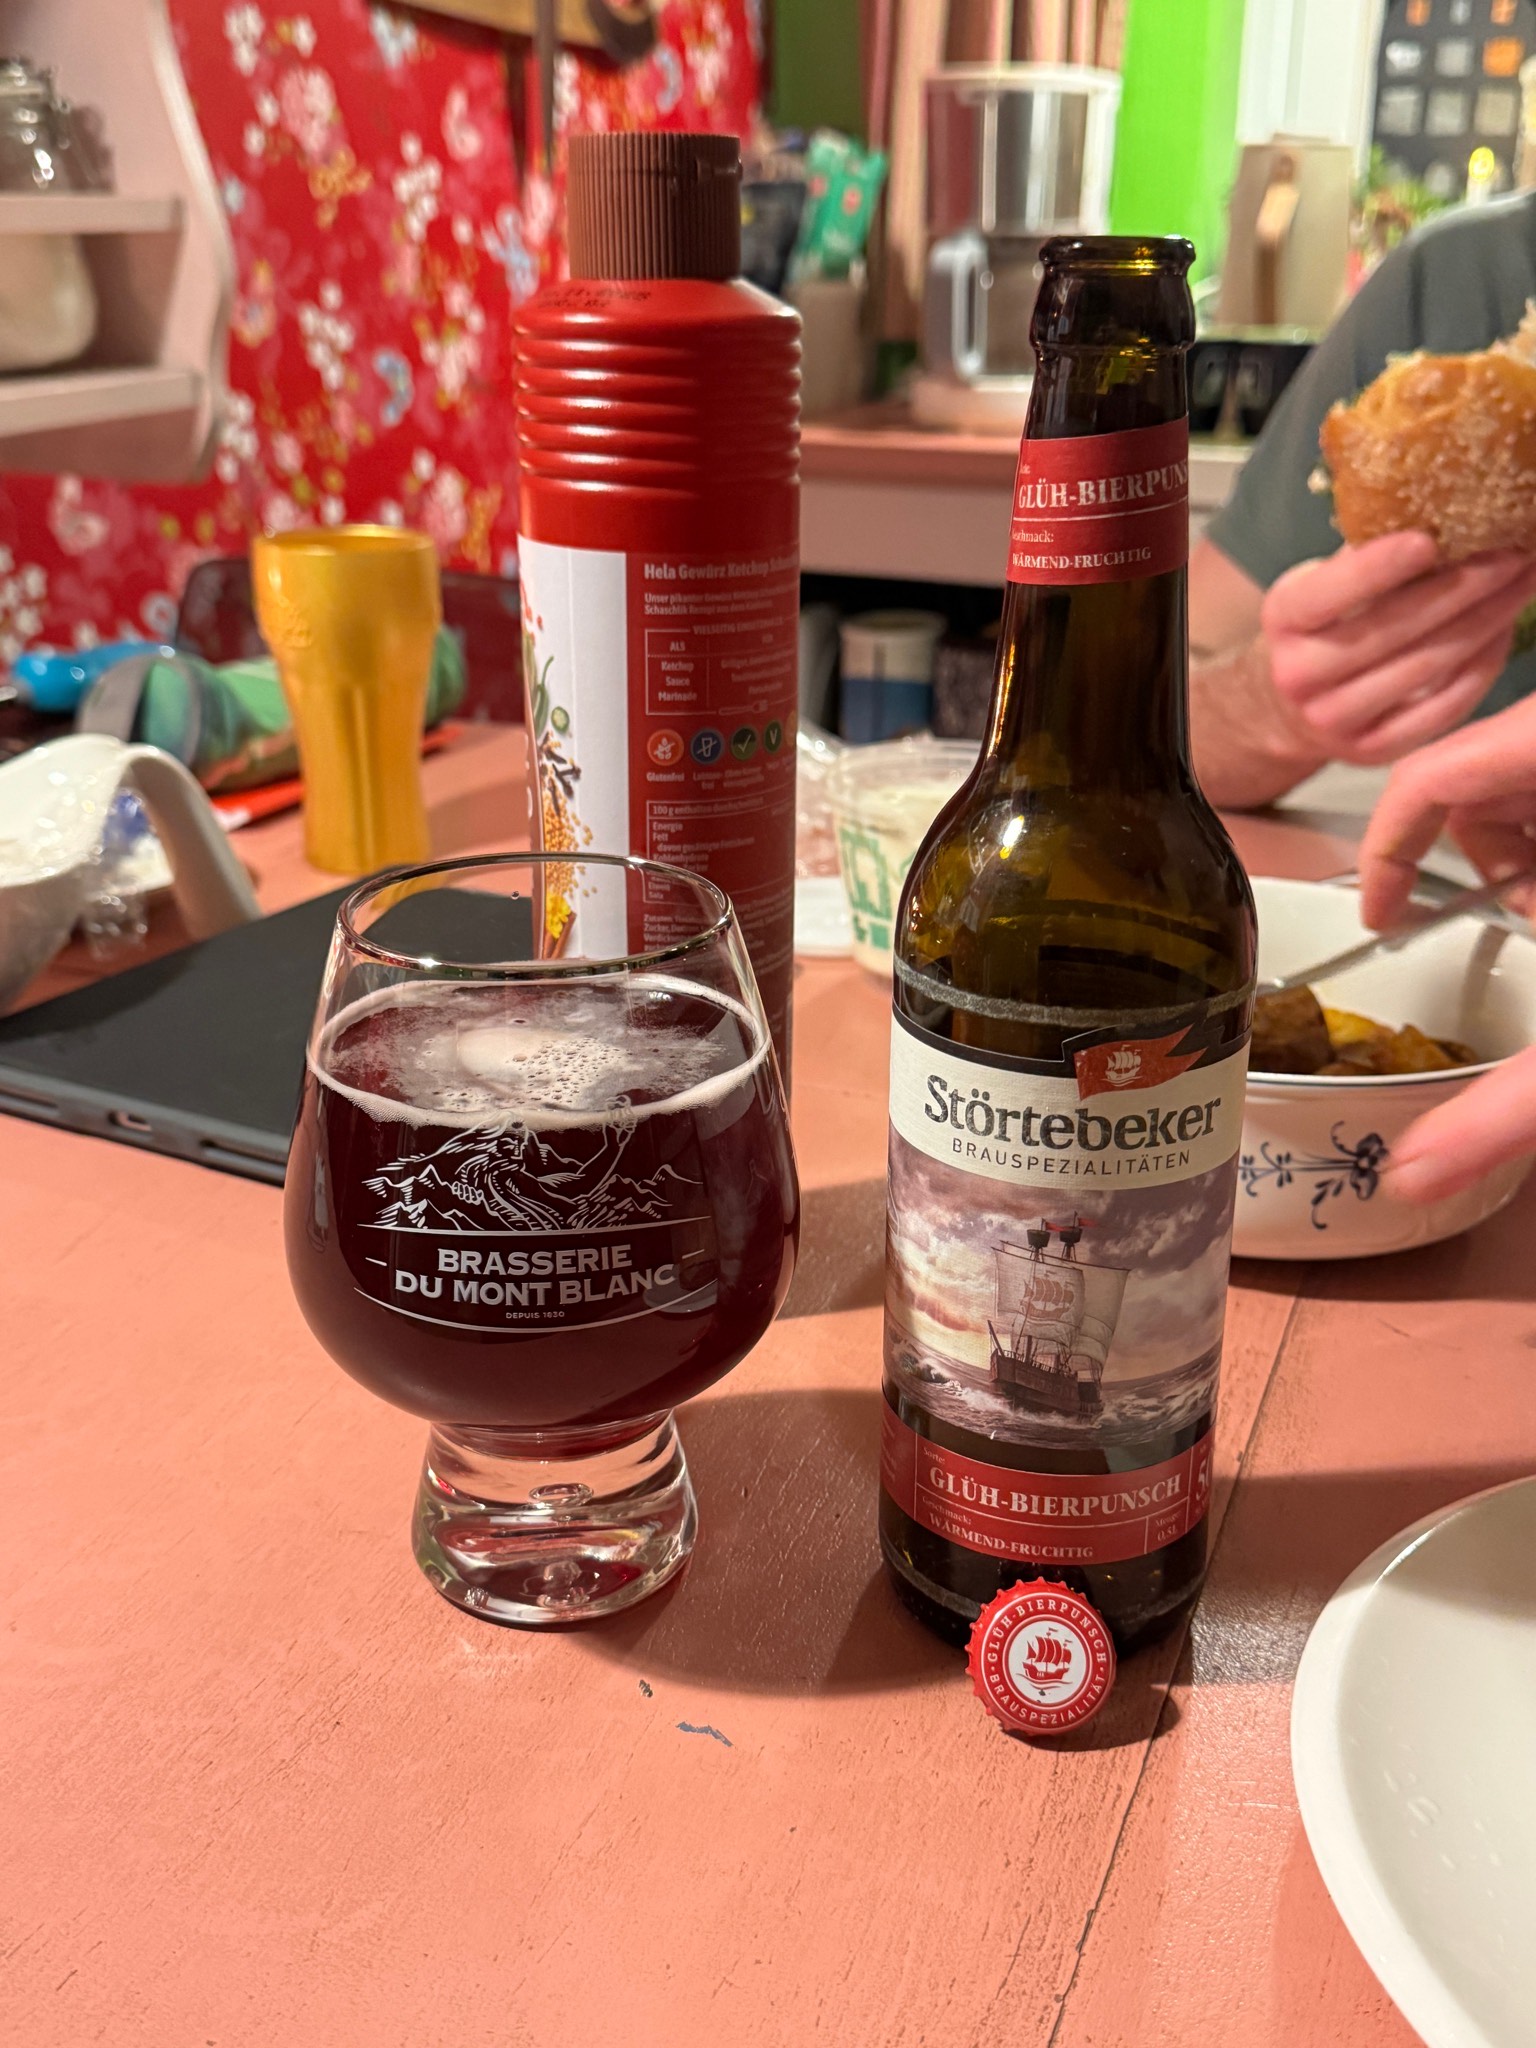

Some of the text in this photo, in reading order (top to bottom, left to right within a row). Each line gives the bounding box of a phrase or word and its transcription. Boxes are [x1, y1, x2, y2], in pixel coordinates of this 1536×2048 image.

[644, 562, 676, 580] Hela
[679, 563, 726, 580] Gewürz
[1012, 546, 1151, 569] WÄRMEND-FRUCHTIG
[669, 640, 686, 652] ALS
[665, 675, 690, 687] Sauce
[924, 1074, 1221, 1152] Störtebeker
[952, 1137, 1190, 1176] BRAUSPEZIALITÄTEN
[437, 1244, 633, 1276] BRASSERIE
[395, 1263, 678, 1307] DU MONT BLANC
[929, 1466, 1182, 1518] GLÜH-BIERPUNSCH
[929, 1512, 1093, 1559] WÄRMEND-FRUCHTIG
[987, 1598, 1107, 1663] GLÜH-BIERPUNSCH
[990, 1673, 1106, 1725] BRAUSPEZIALITÄT
